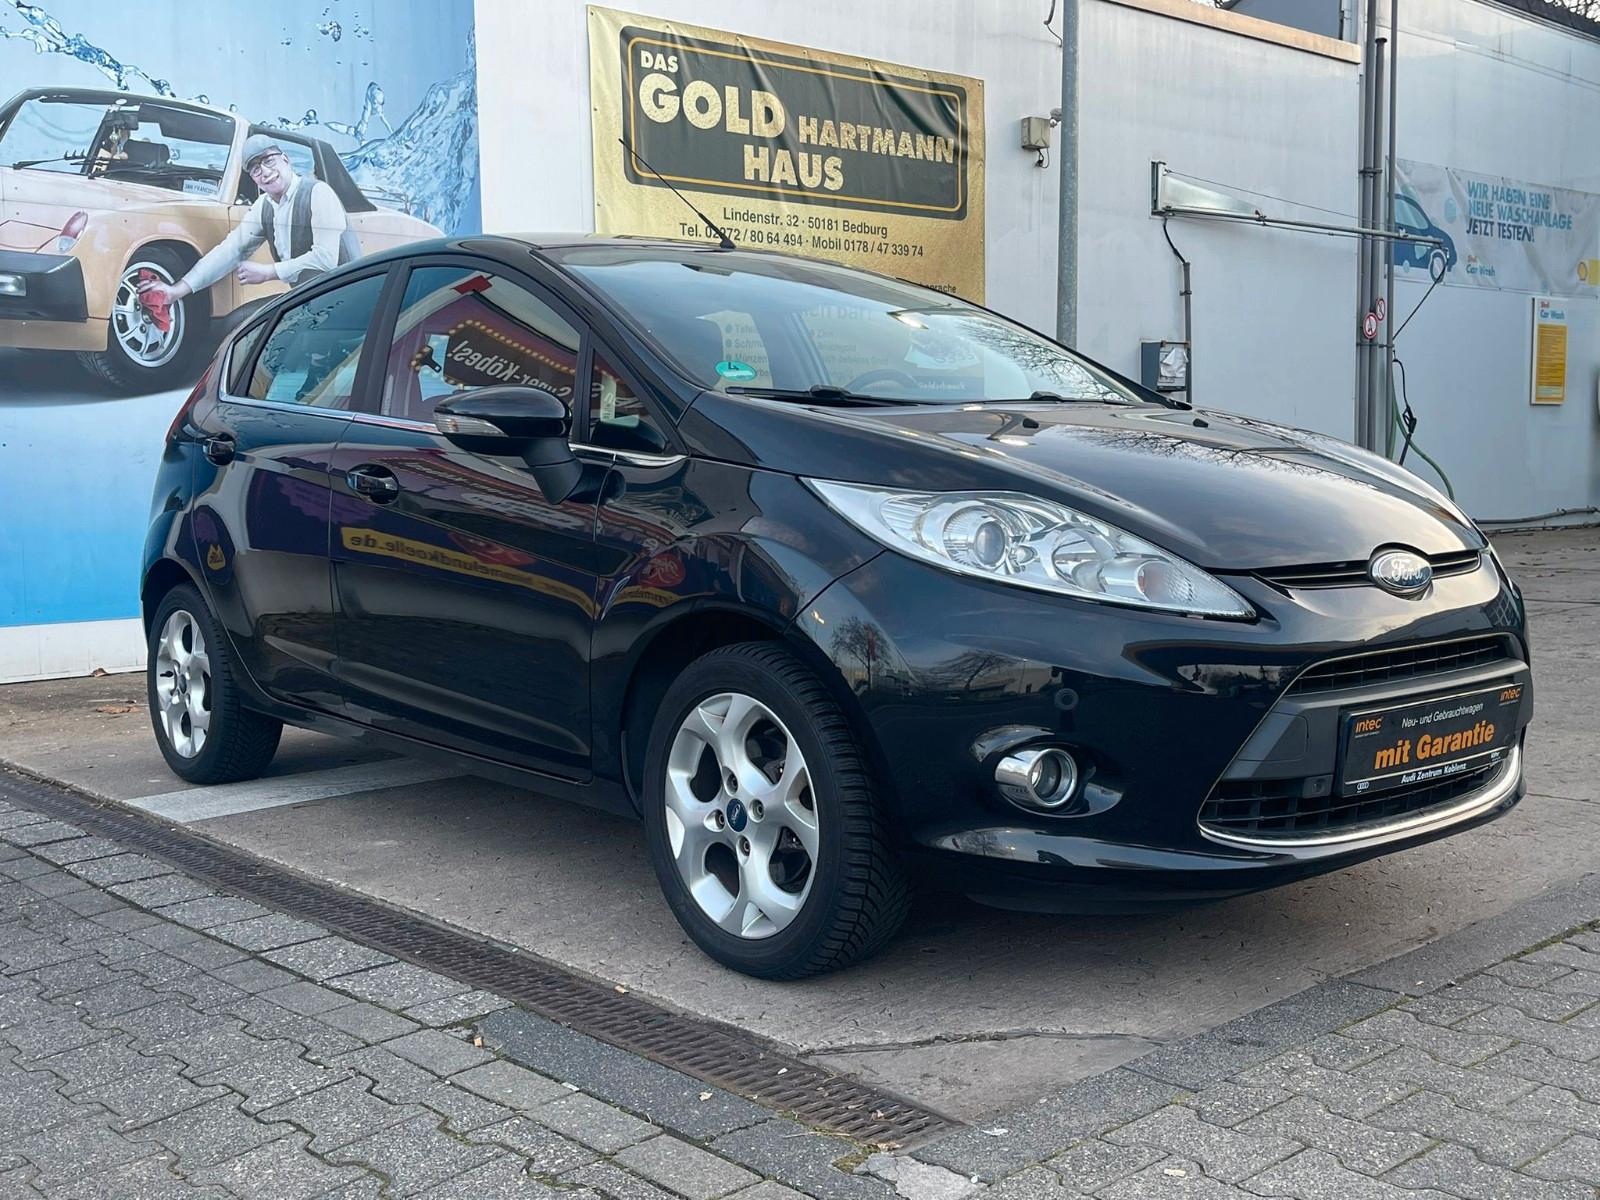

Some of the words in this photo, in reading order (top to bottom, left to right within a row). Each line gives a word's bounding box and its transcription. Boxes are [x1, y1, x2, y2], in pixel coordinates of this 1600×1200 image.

[640, 50, 679, 73] DAS
[639, 73, 786, 138] GOLD
[798, 115, 954, 164] HARTMANN
[743, 144, 844, 190] HAUS
[1468, 180, 1488, 200] WIR
[1492, 185, 1526, 206] HABEN
[1530, 192, 1550, 210] EINE
[723, 207, 783, 226] Lindenstr.
[786, 214, 799, 227] 32
[808, 216, 838, 231] 50181
[842, 220, 888, 239] Bedburg
[1466, 218, 1494, 237] JETZT
[1497, 222, 1535, 242] TESTEN!
[1469, 200, 1494, 219] NEUE
[1497, 204, 1572, 230] WASCHANLAGE
[679, 222, 702, 238] Tel.
[750, 230, 764, 243] 80
[766, 232, 780, 244] 64
[783, 234, 802, 246] 494
[812, 236, 841, 250] Mobil
[844, 239, 868, 253] 0178
[877, 242, 888, 254] 47
[892, 244, 910, 256] 339
[912, 245, 924, 257] 74
[1540, 309, 1550, 318] Car
[1500, 688, 1521, 702] intec
[1355, 719, 1382, 733] intec
[1402, 718, 1418, 728] Neu-
[1420, 713, 1432, 724] und
[1433, 702, 1484, 722] Gebrauchtwagen
[1374, 739, 1411, 770] mit
[1416, 720, 1495, 760] Garantie
[1401, 774, 1416, 784] Audi
[1417, 768, 1442, 781] Zentrum
[1444, 762, 1467, 775] Koblenz
